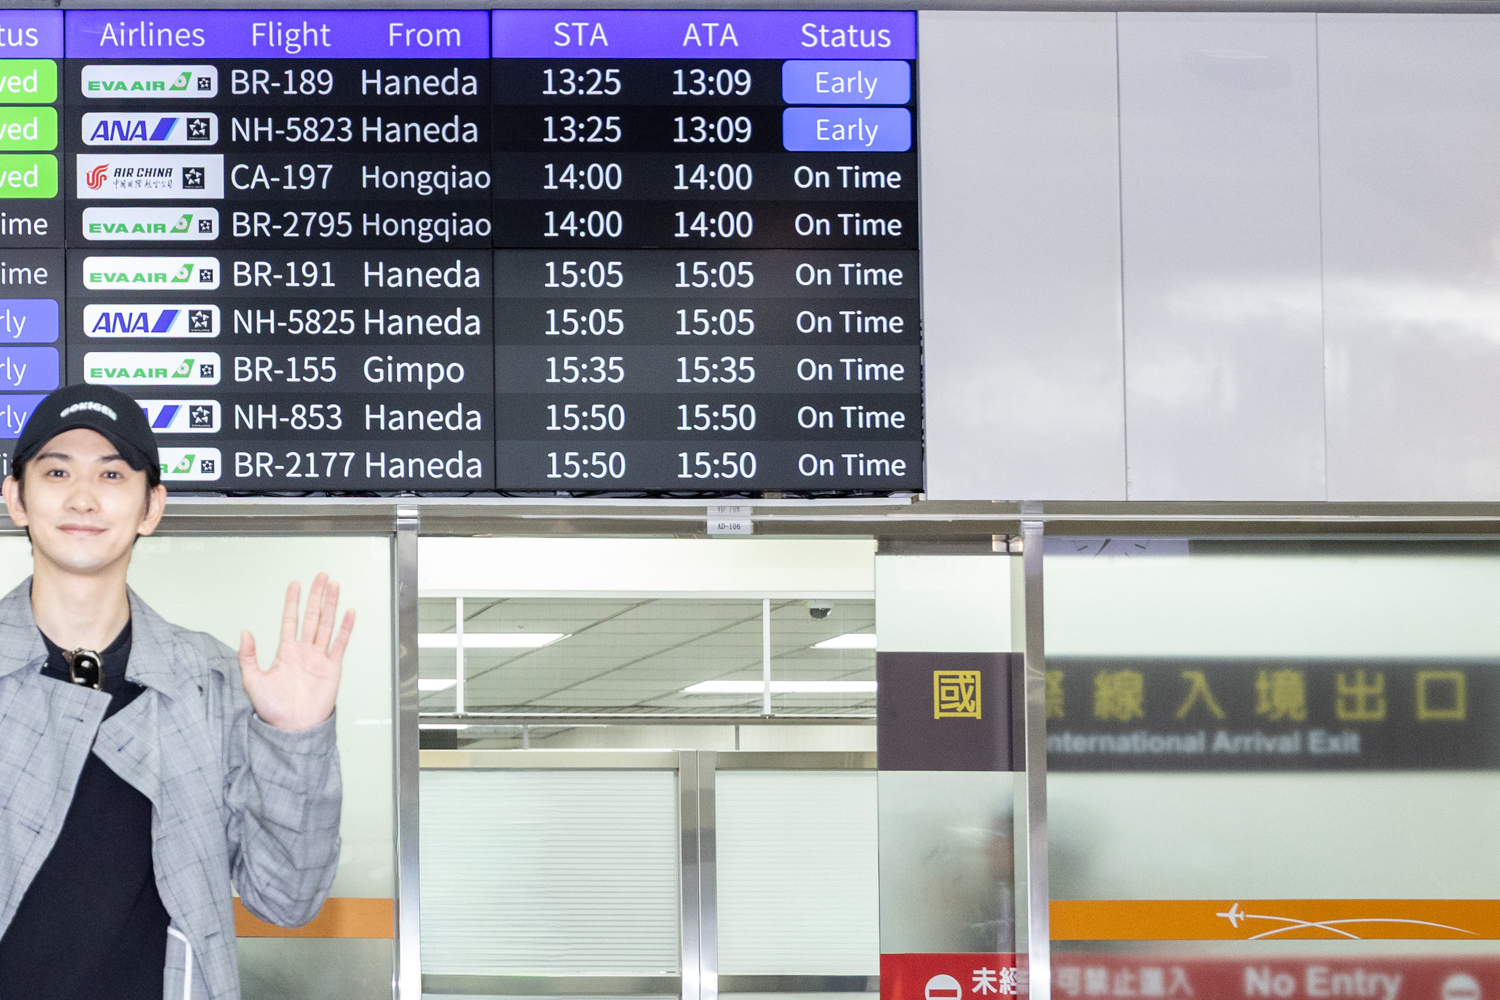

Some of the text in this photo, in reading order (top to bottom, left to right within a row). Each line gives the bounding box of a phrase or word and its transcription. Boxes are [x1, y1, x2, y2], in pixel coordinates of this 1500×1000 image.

[99, 20, 205, 47] Airlines
[252, 20, 331, 55] Flight
[389, 22, 461, 47] From
[553, 21, 609, 47] STA
[682, 22, 739, 47] ATA
[801, 22, 892, 48] Status
[88, 80, 165, 91] EVA AIR
[231, 68, 334, 95] BR-189
[361, 67, 478, 96] Haneda
[542, 68, 621, 96] 13:25
[672, 68, 752, 96] 13:09
[816, 70, 878, 100] Early
[231, 116, 353, 143] NH-5823
[362, 114, 478, 143] Haneda
[542, 115, 622, 143] 13:25
[673, 115, 752, 143] 13:09
[816, 117, 879, 147] Early
[114, 167, 173, 177] AIR CHINA
[230, 163, 333, 190] CA-197
[362, 164, 491, 196] Hongqiao
[543, 163, 622, 190] 14:00
[673, 163, 753, 191] 14:00
[794, 165, 902, 189] On Time
[232, 211, 353, 238] BR-2795
[362, 211, 492, 244] Hongqiao
[543, 210, 623, 238] 14:00
[674, 210, 753, 238] 14:00
[794, 212, 902, 237] On Time
[233, 260, 336, 288] BR-191
[364, 259, 480, 288] Haneda
[544, 260, 624, 288] 15:05
[675, 261, 754, 289] 15:05
[795, 262, 903, 286] On Time
[233, 308, 355, 335] NH-5825
[364, 306, 481, 336] Haneda
[545, 308, 624, 336] 15:05
[675, 308, 755, 336] 15:05
[234, 356, 337, 383] BR-155
[363, 355, 465, 391] Gimpo
[545, 356, 625, 384] 15:35
[676, 356, 755, 384] 15:35
[234, 403, 343, 431] NH-853
[365, 402, 482, 431] Haneda
[546, 403, 625, 431] 15:50
[676, 403, 756, 431] 15:50
[235, 451, 356, 478] BR-2177
[365, 449, 482, 479] Haneda
[546, 451, 626, 479] 15:50
[677, 451, 757, 479] 15:50
[798, 453, 907, 477] On Time
[1046, 731, 1361, 755] nternational Arrival Exit
[1244, 967, 1295, 998] No
